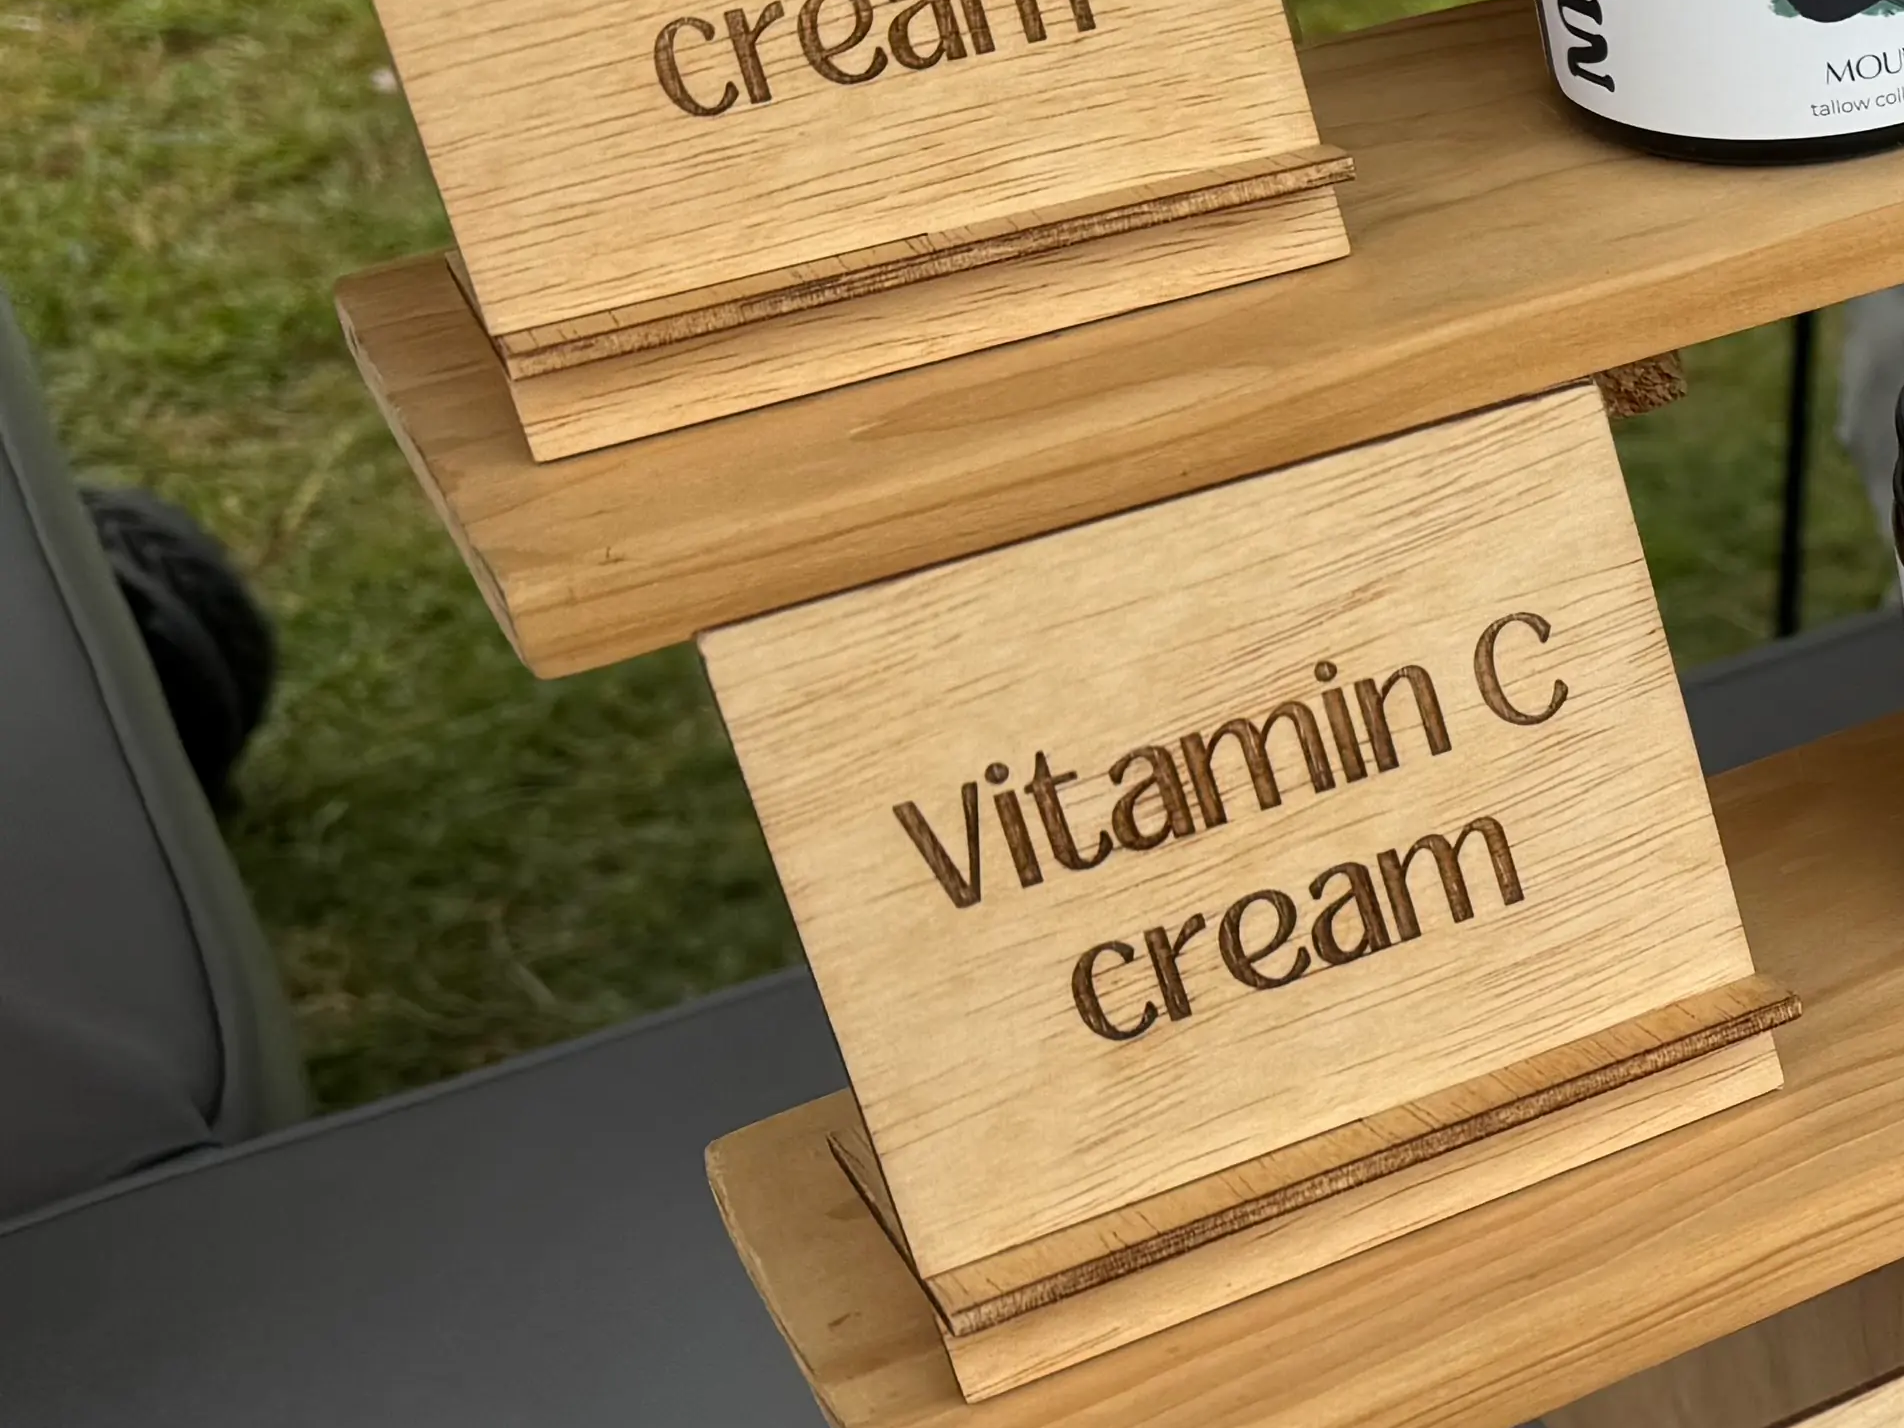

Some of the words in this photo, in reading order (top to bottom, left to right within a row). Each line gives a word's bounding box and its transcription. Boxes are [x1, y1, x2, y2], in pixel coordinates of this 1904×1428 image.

[1811, 98, 1870, 117] tallow
[893, 661, 1452, 908] Vitamin
[1473, 611, 1568, 726] C
[1071, 814, 1525, 1040] cream
